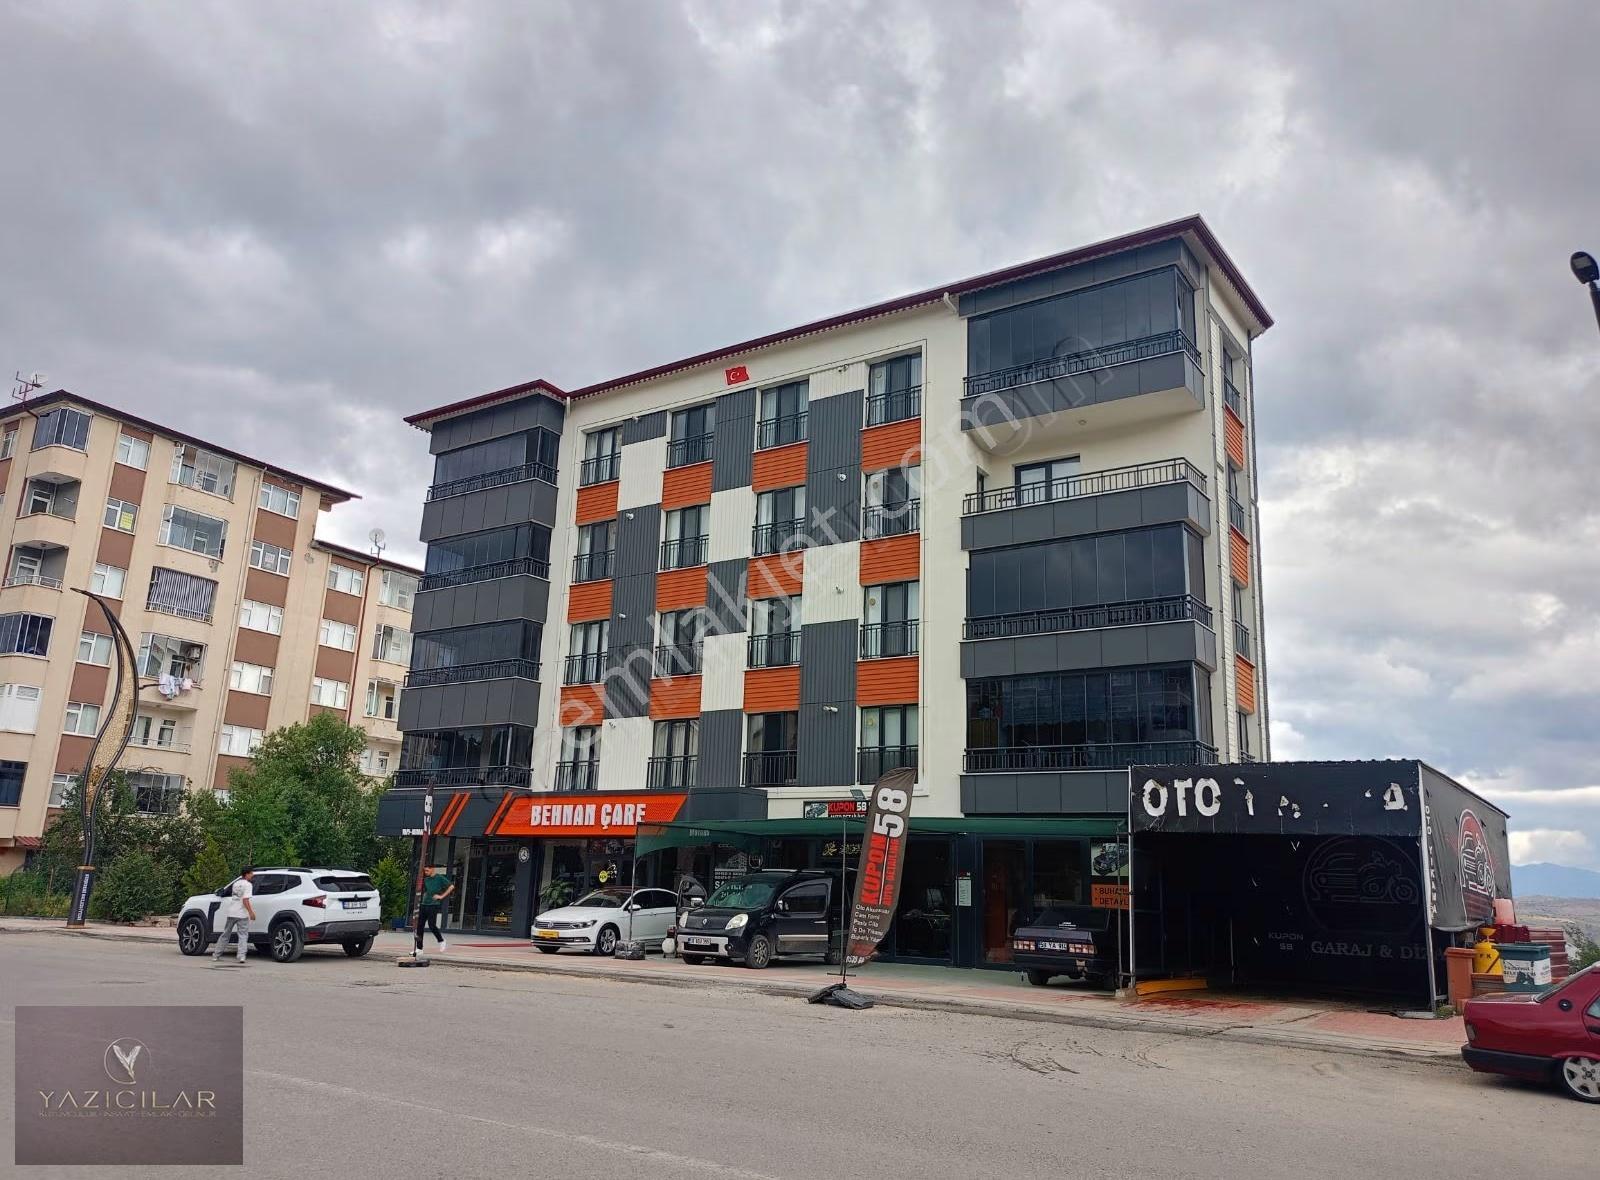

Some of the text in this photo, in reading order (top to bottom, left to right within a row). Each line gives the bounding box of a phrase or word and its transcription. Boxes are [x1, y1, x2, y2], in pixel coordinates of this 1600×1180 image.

[828, 801, 867, 812] KUPON 58
[1143, 778, 1221, 817] OTO
[861, 787, 908, 905] KUPON 58
[1311, 941, 1372, 957] GARAJ
